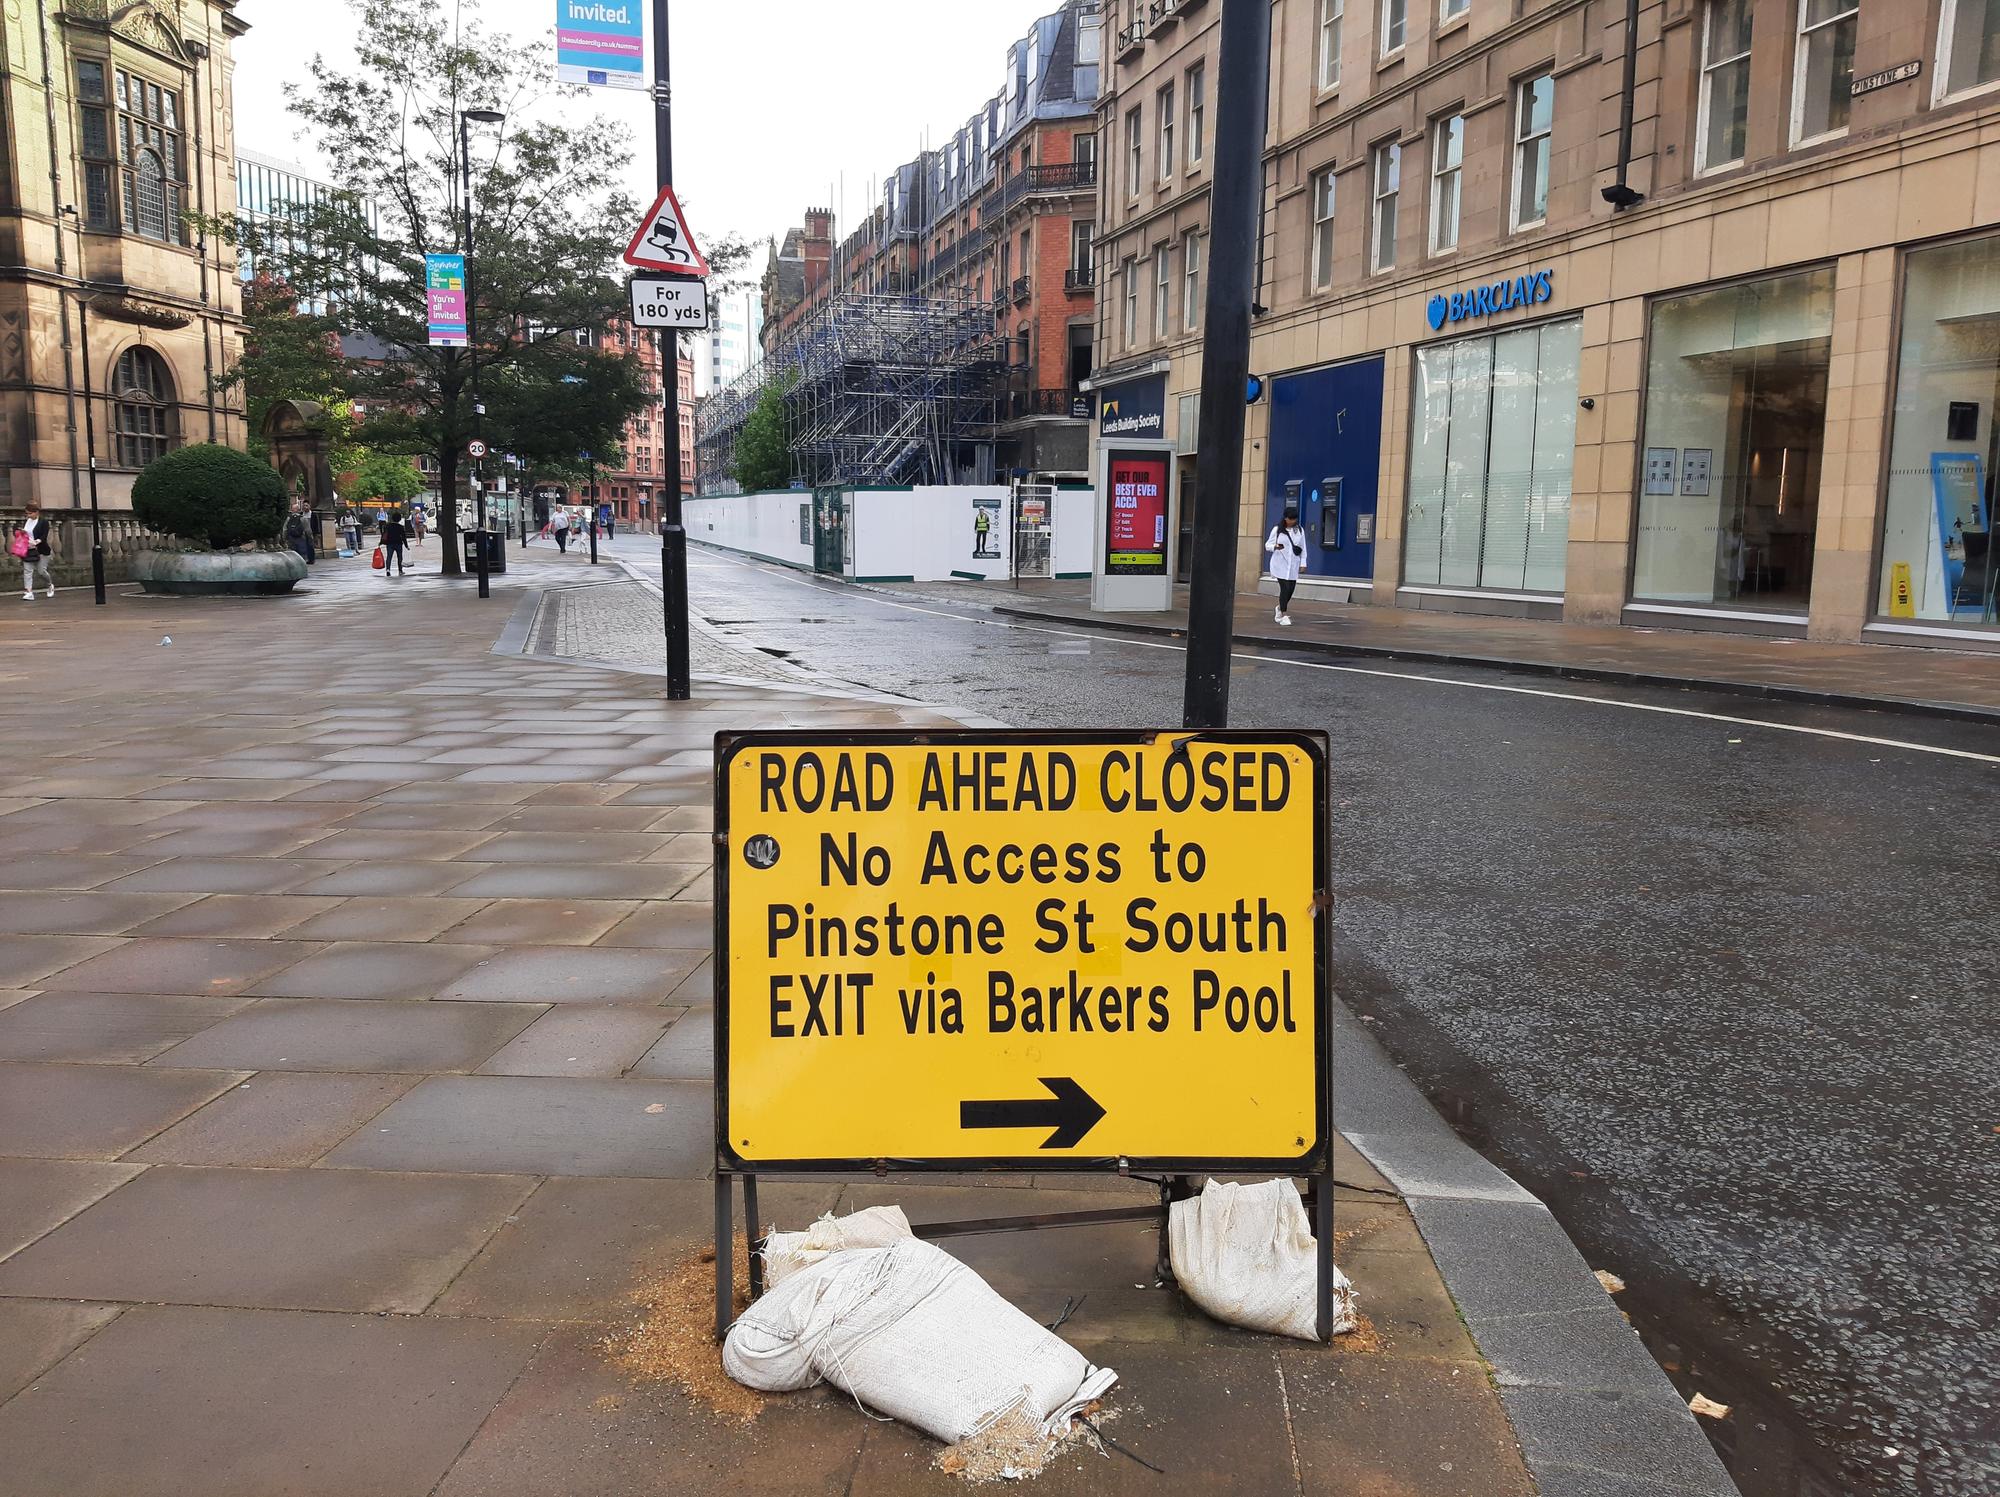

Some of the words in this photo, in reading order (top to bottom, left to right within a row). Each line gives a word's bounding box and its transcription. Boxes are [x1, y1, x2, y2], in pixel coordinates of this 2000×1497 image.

[568, 1, 632, 24] invited.
[1854, 70, 1897, 93] PINSTONE
[432, 294, 456, 303] You're
[656, 287, 681, 300] For
[1448, 269, 1553, 321] BARCLAYS
[433, 303, 442, 311] all
[433, 310, 461, 320] invited.
[638, 304, 668, 318] 180
[674, 305, 701, 321] yds
[1102, 420, 1117, 434] Leeds
[1118, 417, 1138, 432] Building
[1138, 413, 1160, 429] Society
[470, 444, 484, 453] 20
[1115, 483, 1135, 496] BEST
[1137, 484, 1157, 496] EVER
[1115, 496, 1137, 508] ACCA
[760, 751, 894, 813] ROAD
[918, 751, 1076, 812] AHEAD
[1100, 750, 1290, 813] CLOSED
[820, 832, 891, 886] No
[920, 830, 1121, 884] Access
[1150, 828, 1206, 883] to
[768, 902, 1005, 958] Pinstone
[1034, 898, 1095, 953] St
[1125, 897, 1287, 952] South
[770, 973, 873, 1037] EXIT
[898, 971, 964, 1035] via
[988, 970, 1170, 1033] Barkers
[1193, 969, 1296, 1033] Pool
